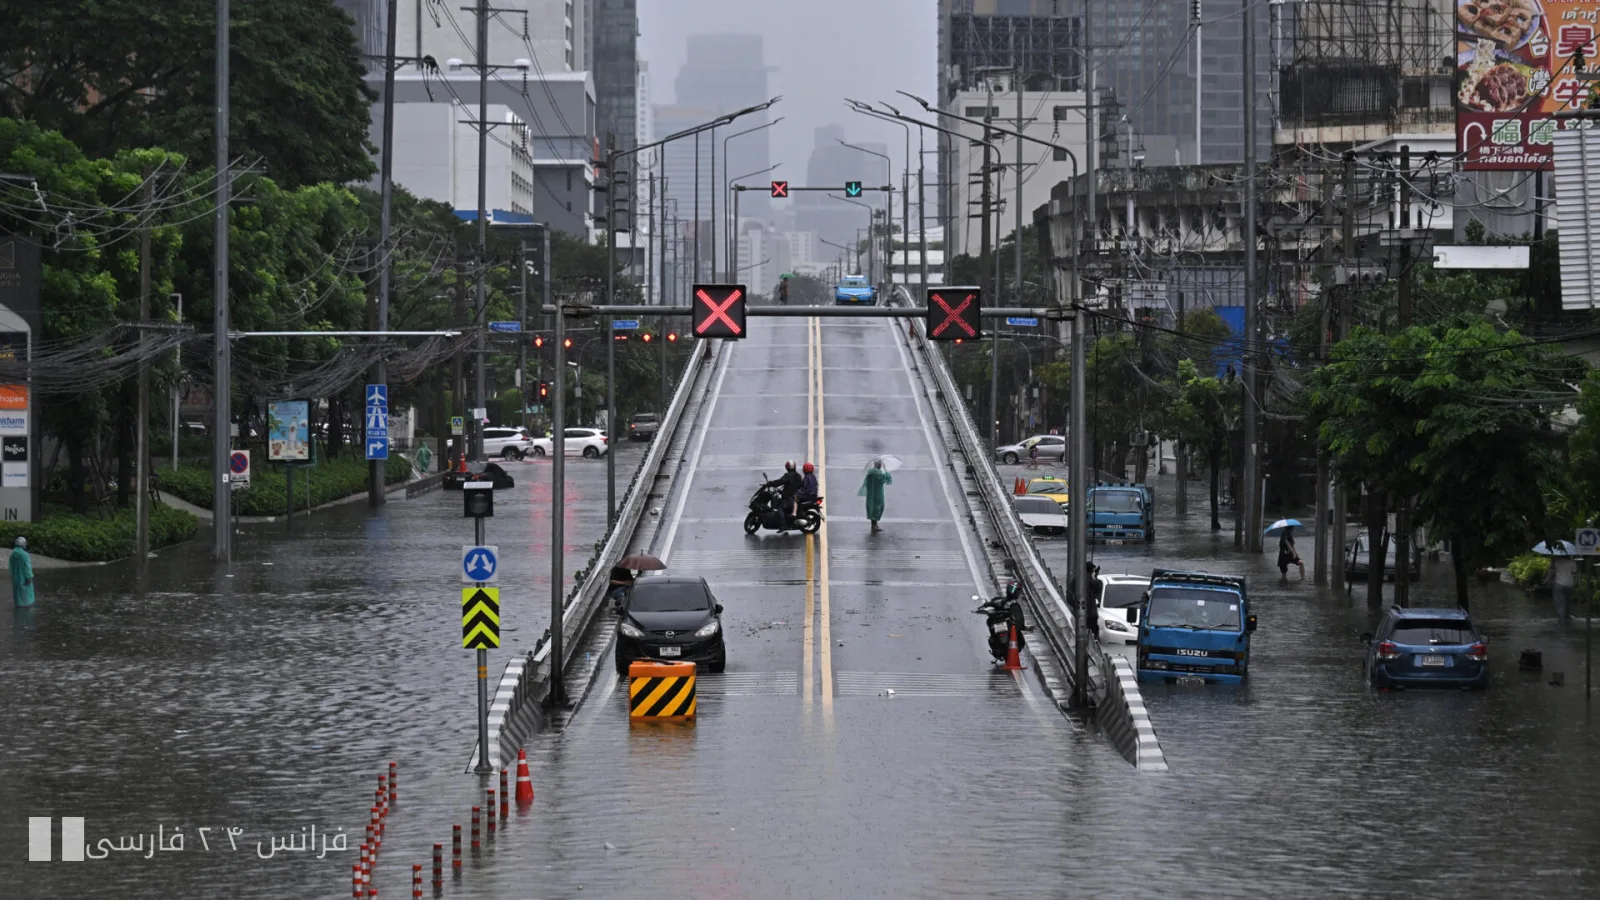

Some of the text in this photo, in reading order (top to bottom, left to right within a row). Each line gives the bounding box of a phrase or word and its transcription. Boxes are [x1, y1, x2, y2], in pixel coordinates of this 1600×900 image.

[5, 443, 25, 455] Regus
[4, 507, 17, 520] IN
[1176, 648, 1208, 657] ISUZU
